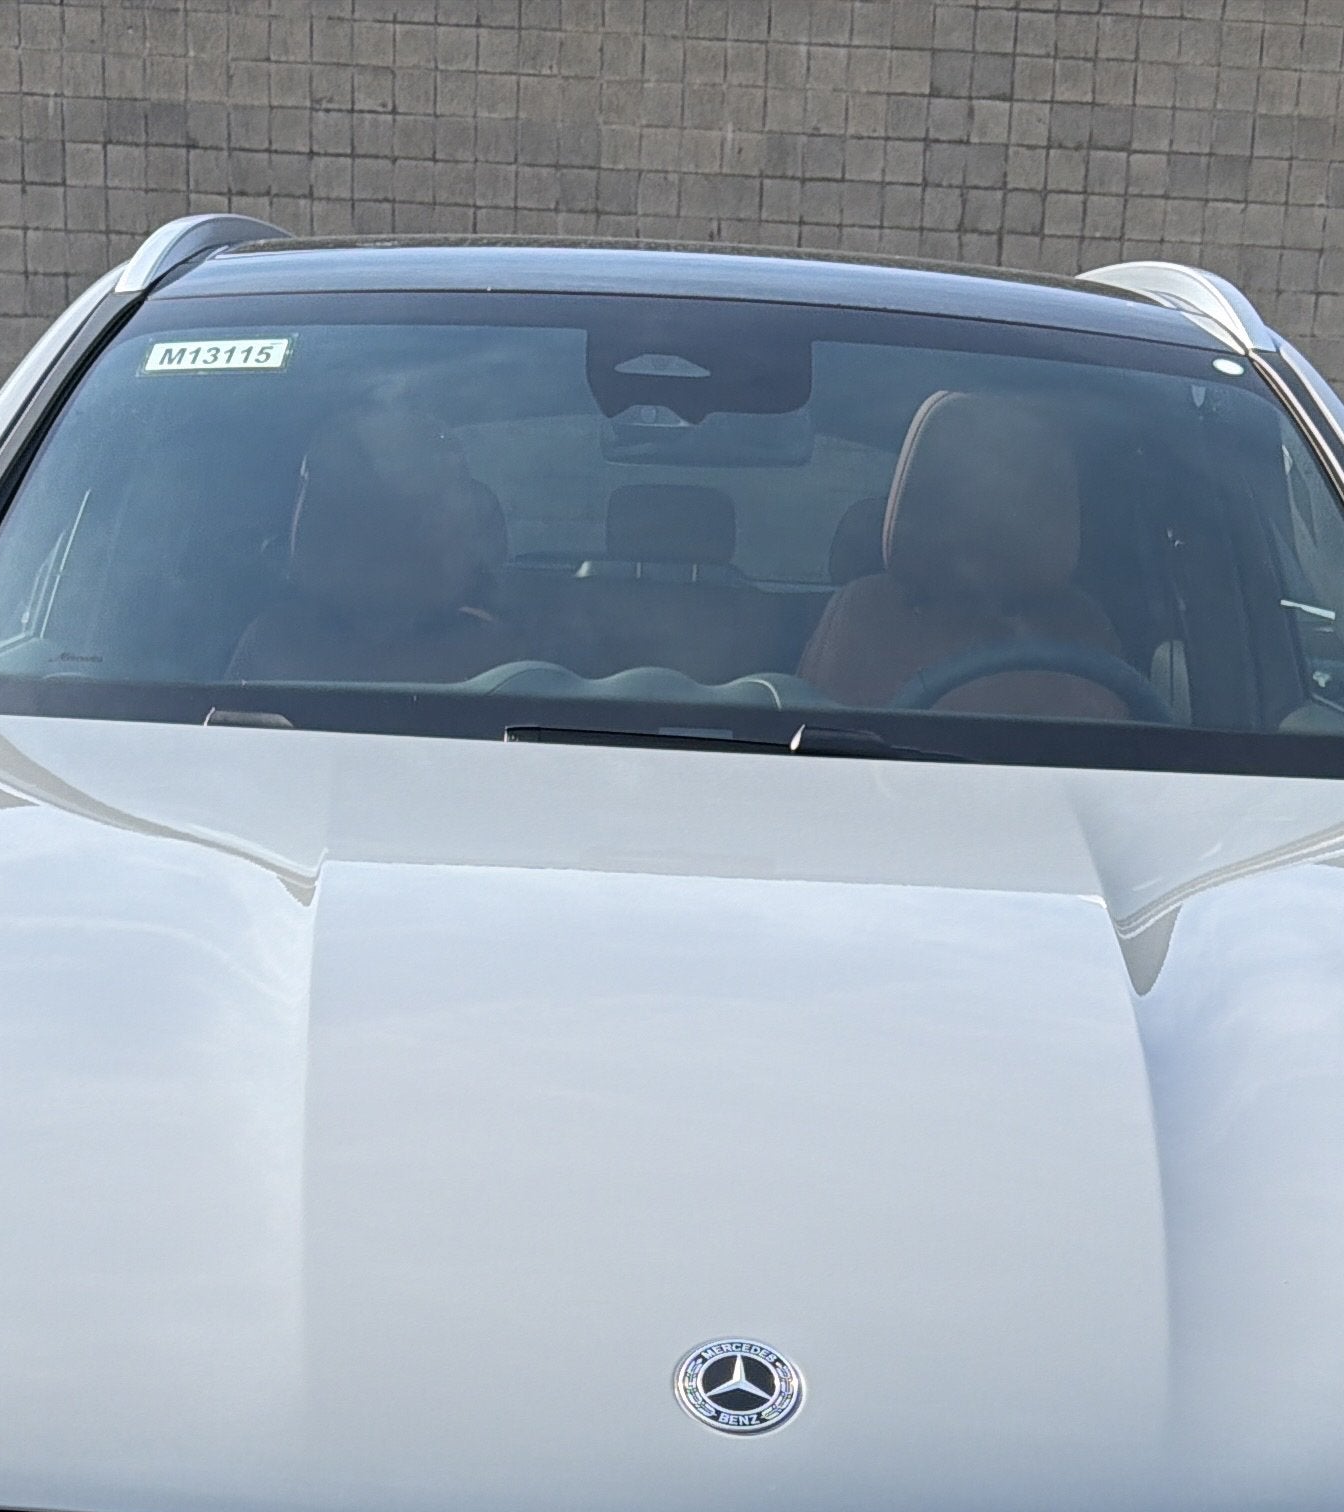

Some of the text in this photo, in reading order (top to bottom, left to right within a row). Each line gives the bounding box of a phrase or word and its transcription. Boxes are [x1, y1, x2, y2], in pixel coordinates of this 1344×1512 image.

[159, 346, 273, 366] M13115
[701, 1343, 777, 1363] MERCEDES
[718, 1412, 761, 1426] BENZ
